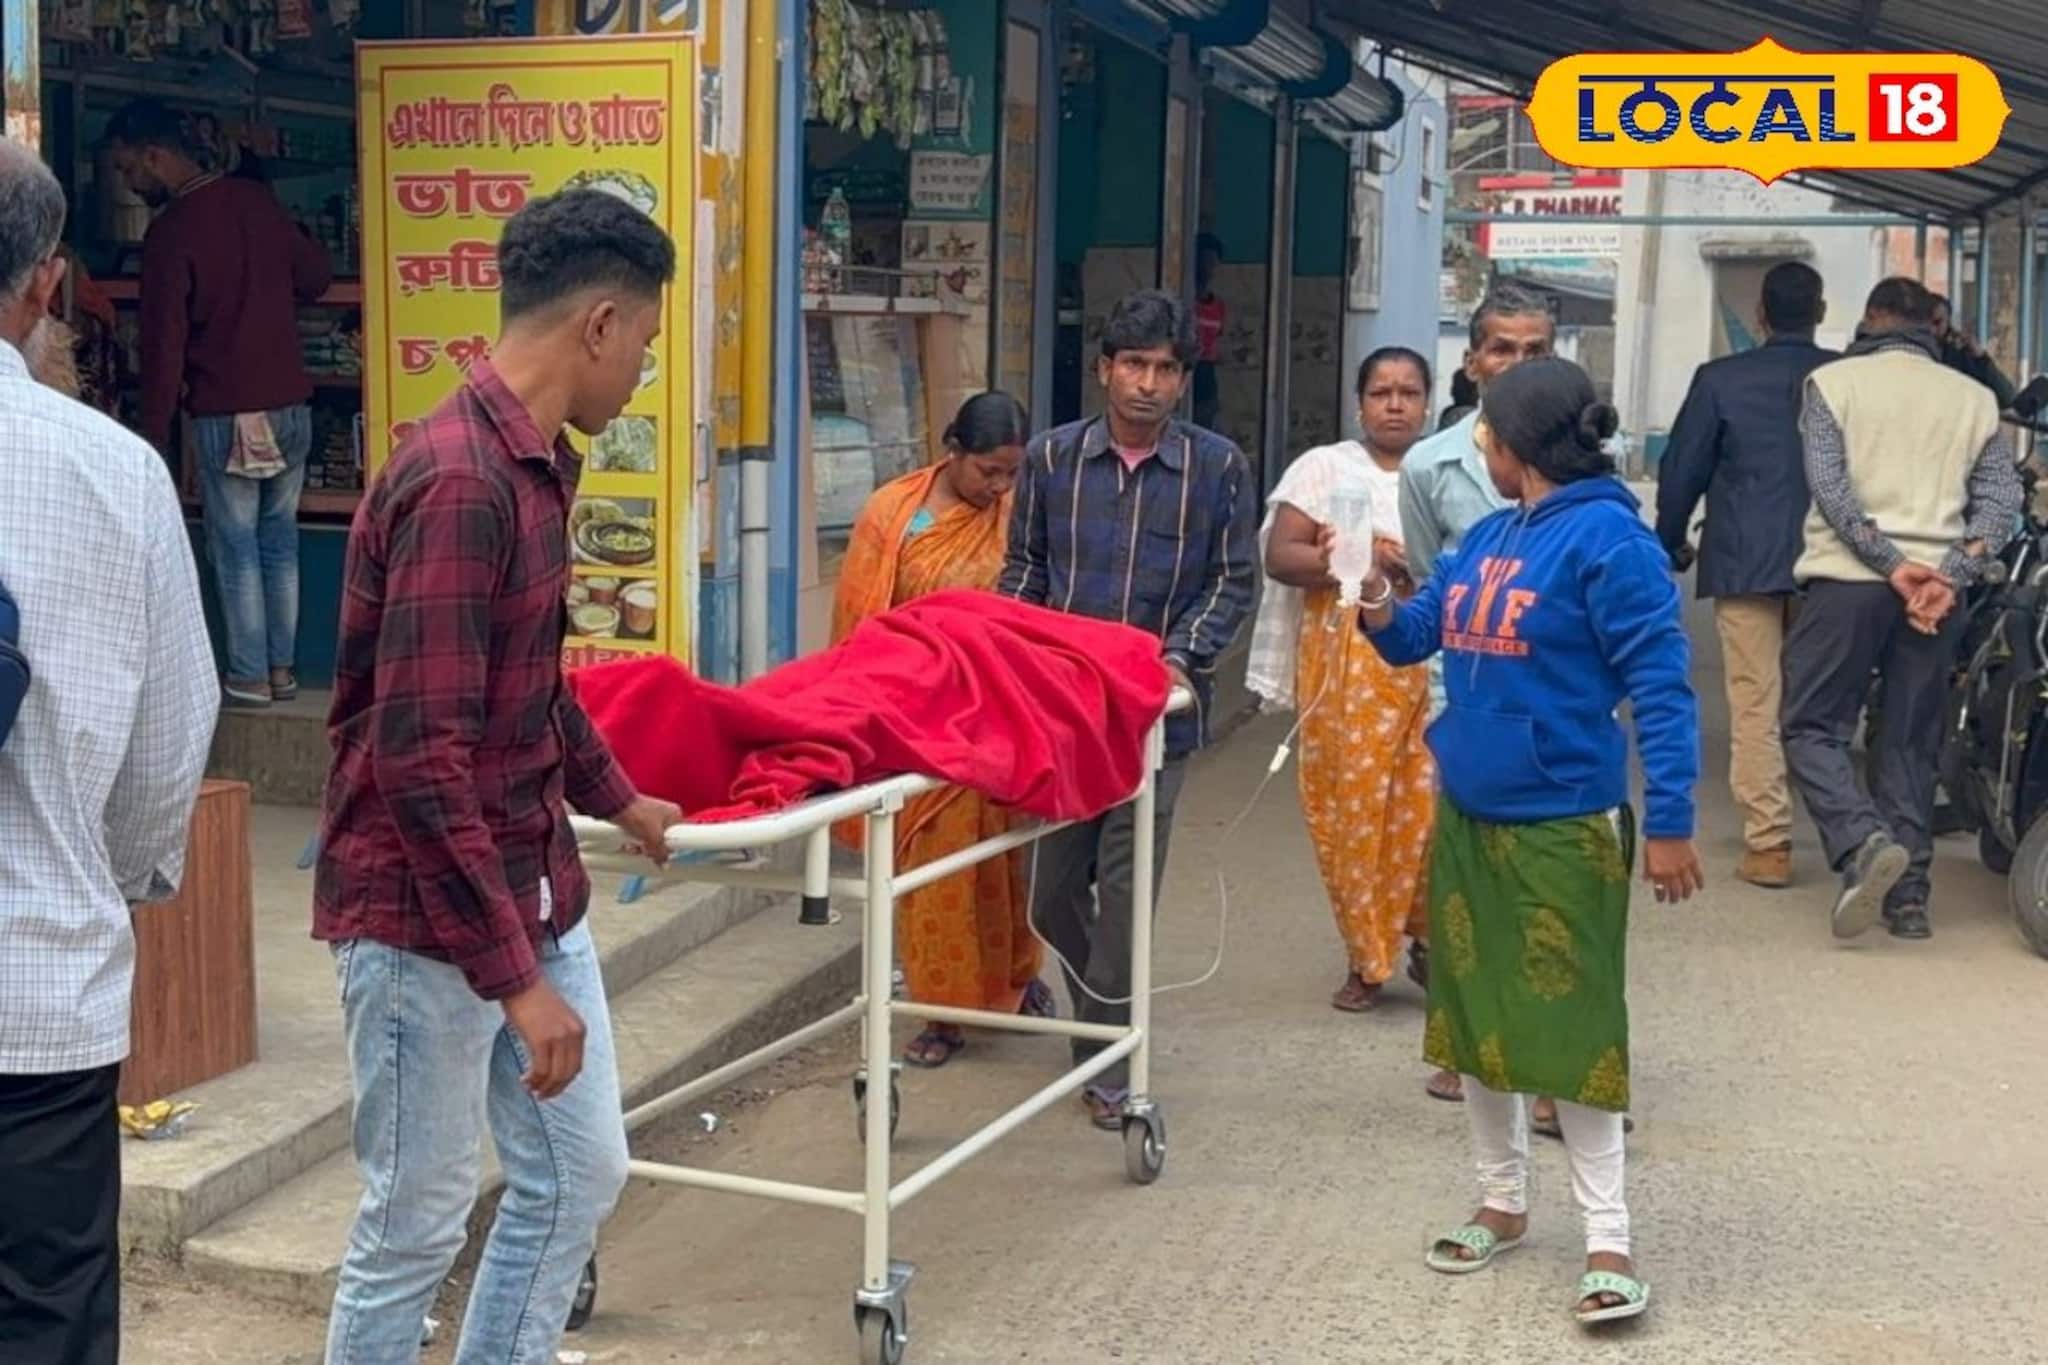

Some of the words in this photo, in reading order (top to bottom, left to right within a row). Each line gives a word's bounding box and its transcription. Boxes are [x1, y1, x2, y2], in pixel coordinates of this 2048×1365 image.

[387, 97, 485, 148] এখানে
[489, 83, 554, 153] দিনে
[558, 100, 588, 148] ও
[590, 95, 665, 153] রাতে
[393, 167, 532, 217] ভাত
[395, 240, 501, 297] রুটি
